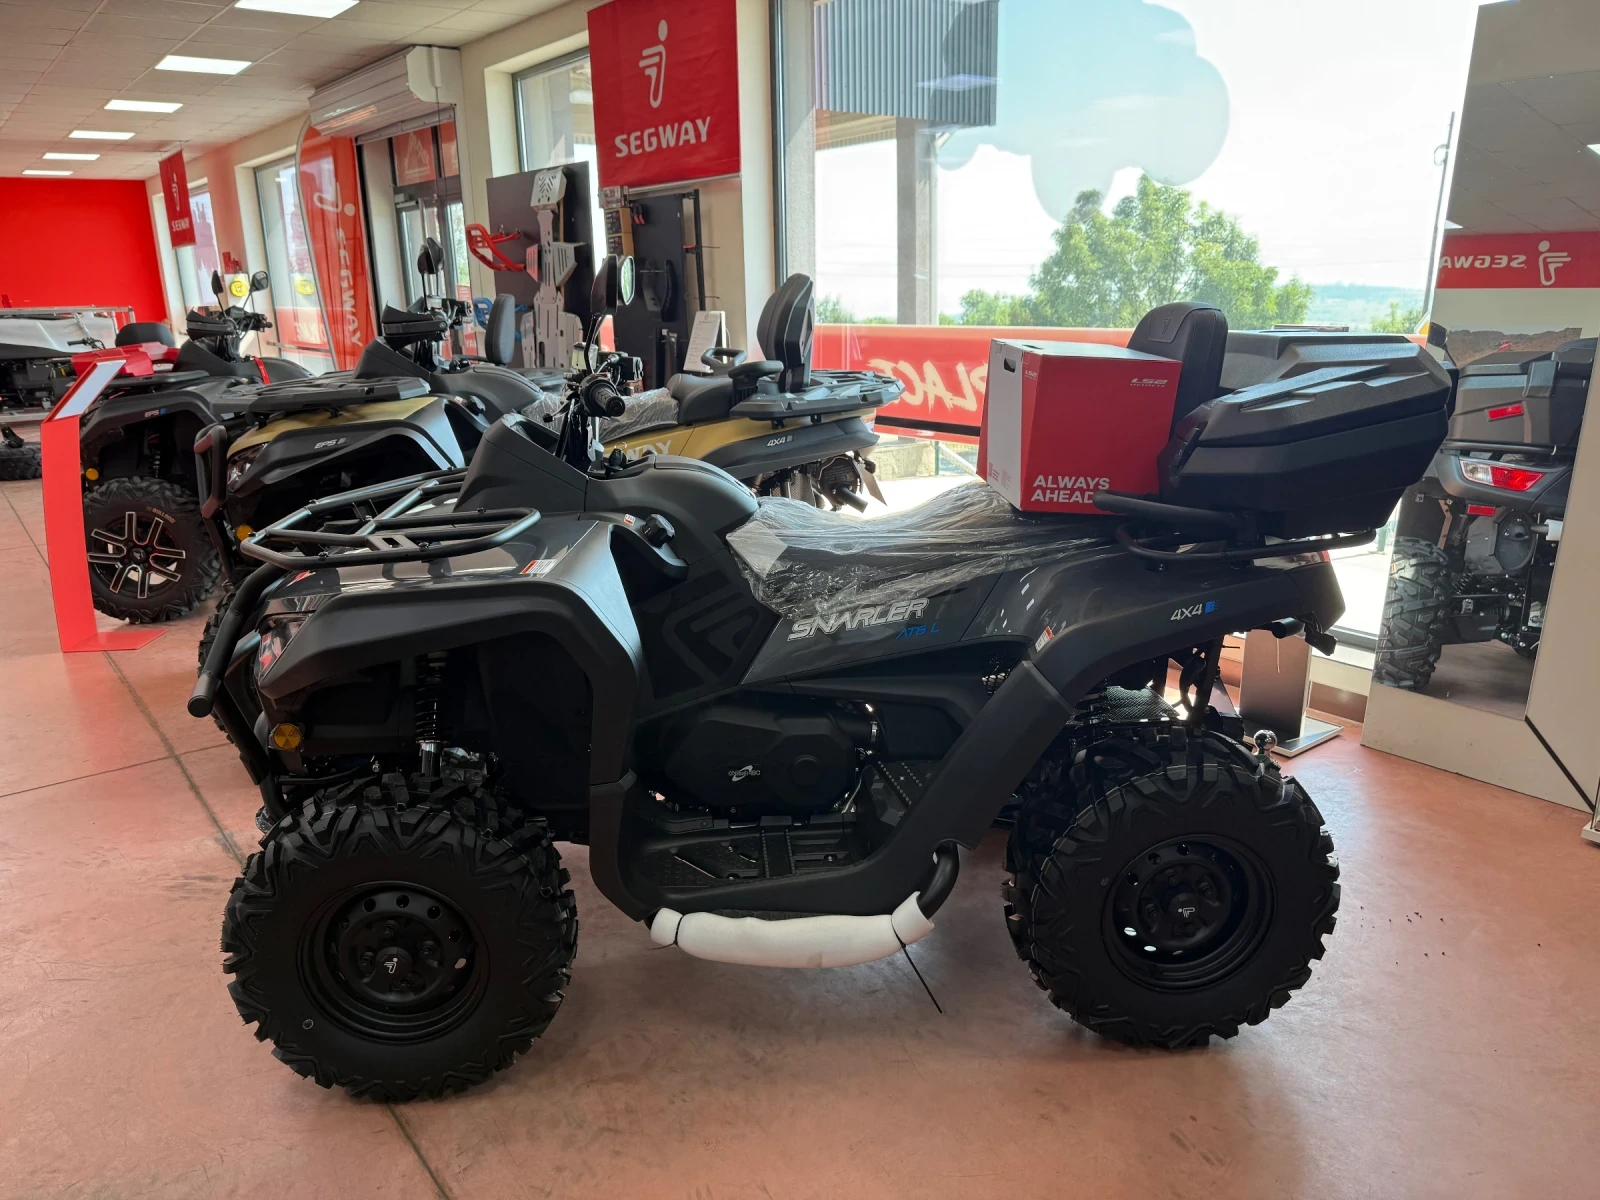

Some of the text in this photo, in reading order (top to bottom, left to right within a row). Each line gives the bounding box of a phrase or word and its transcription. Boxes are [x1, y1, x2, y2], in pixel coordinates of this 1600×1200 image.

[614, 116, 711, 158] SEGWAY
[336, 227, 363, 348] SEGWAY
[314, 439, 338, 449] EPS
[766, 436, 786, 447] 4X4
[1032, 475, 1110, 490] ALWAYS
[1030, 489, 1095, 504] AHEAD
[787, 597, 930, 642] SNARLER
[1170, 603, 1203, 621] 4X4
[896, 623, 940, 640] AT6 L
